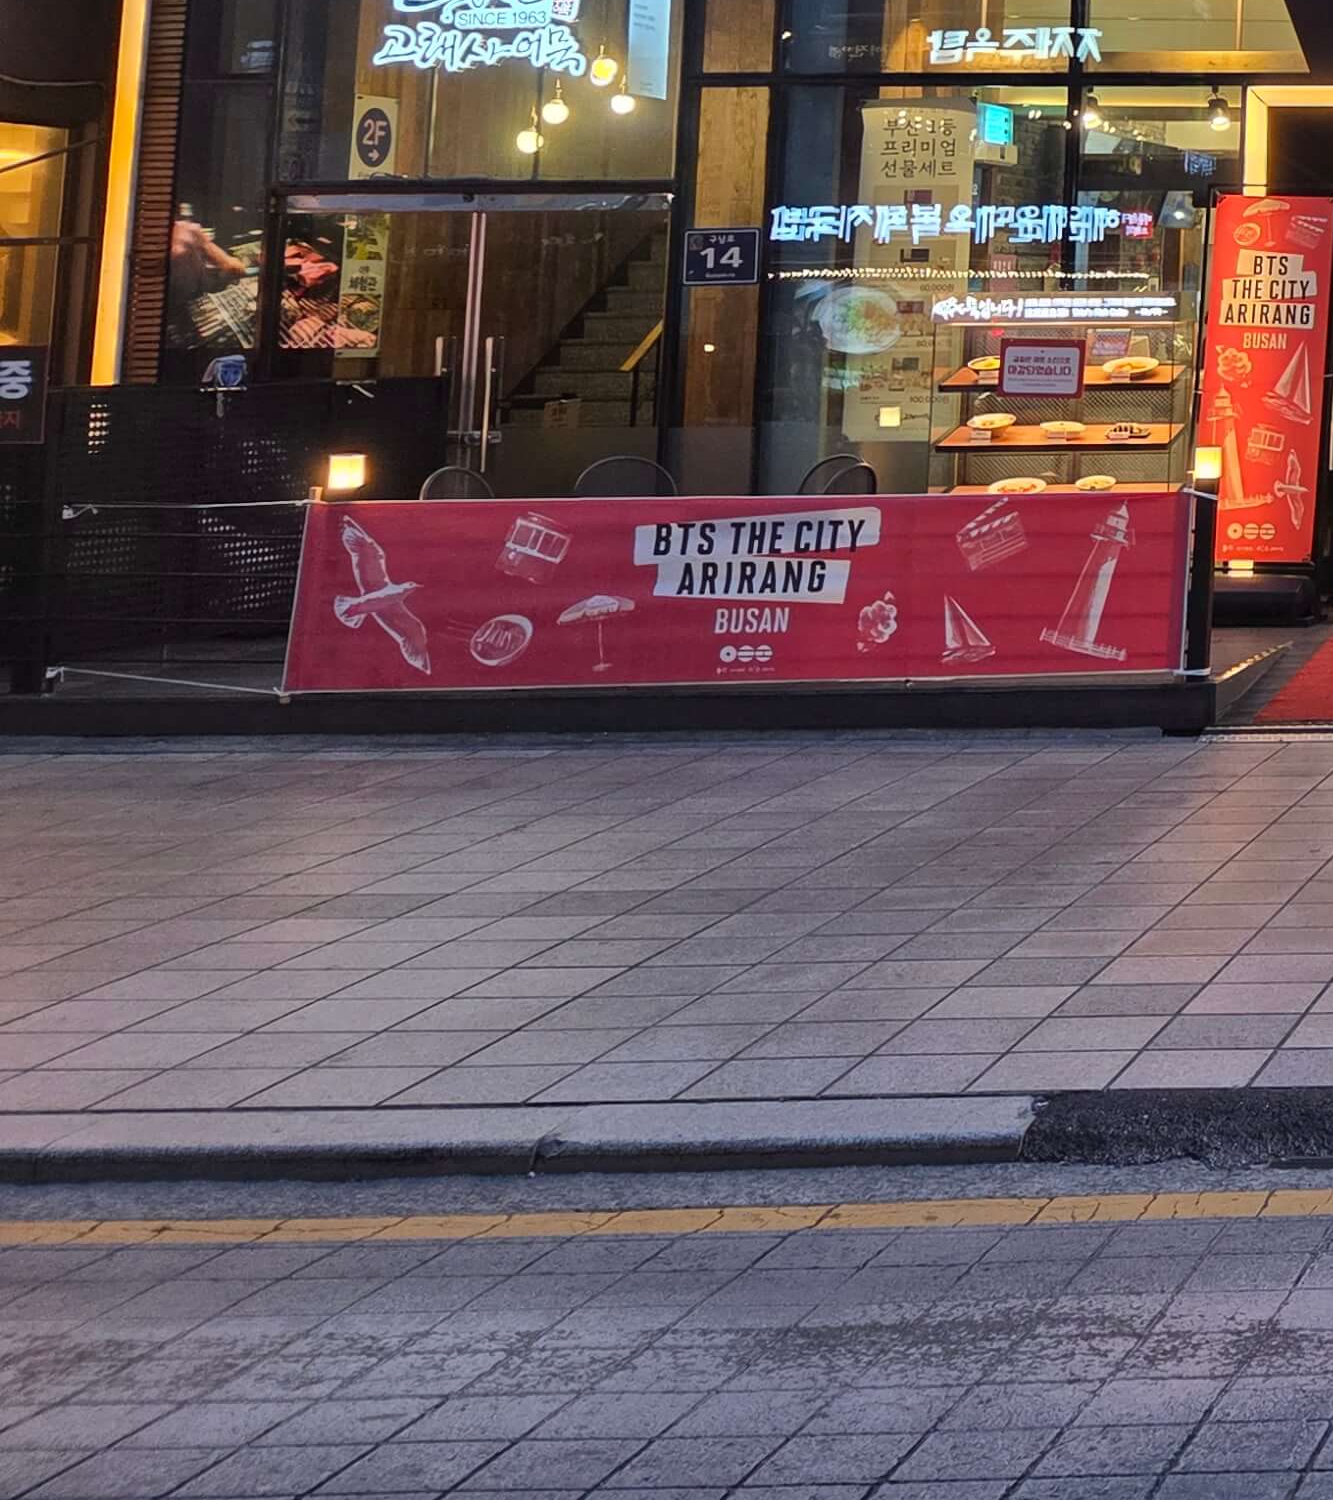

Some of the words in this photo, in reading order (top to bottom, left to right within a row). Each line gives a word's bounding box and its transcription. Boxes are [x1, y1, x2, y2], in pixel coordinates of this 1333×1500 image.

[458, 11, 507, 26] SINCE
[512, 11, 546, 26] 1963
[373, 21, 586, 77] 고래사어묵
[362, 118, 387, 146] 2F
[880, 138, 957, 158] 프리미엄
[880, 159, 957, 178] 선물세트
[700, 246, 743, 269] 14
[1253, 255, 1289, 276] BTS
[1232, 279, 1264, 300] THE
[1269, 279, 1310, 300] CITY
[1224, 304, 1312, 325] ARIRANG
[1243, 332, 1288, 350] BUSAN
[653, 523, 716, 556] BTS
[730, 521, 785, 555] THE
[794, 519, 866, 553] CITY
[676, 560, 827, 596] ARIRANG
[714, 607, 790, 634] BUSAN
